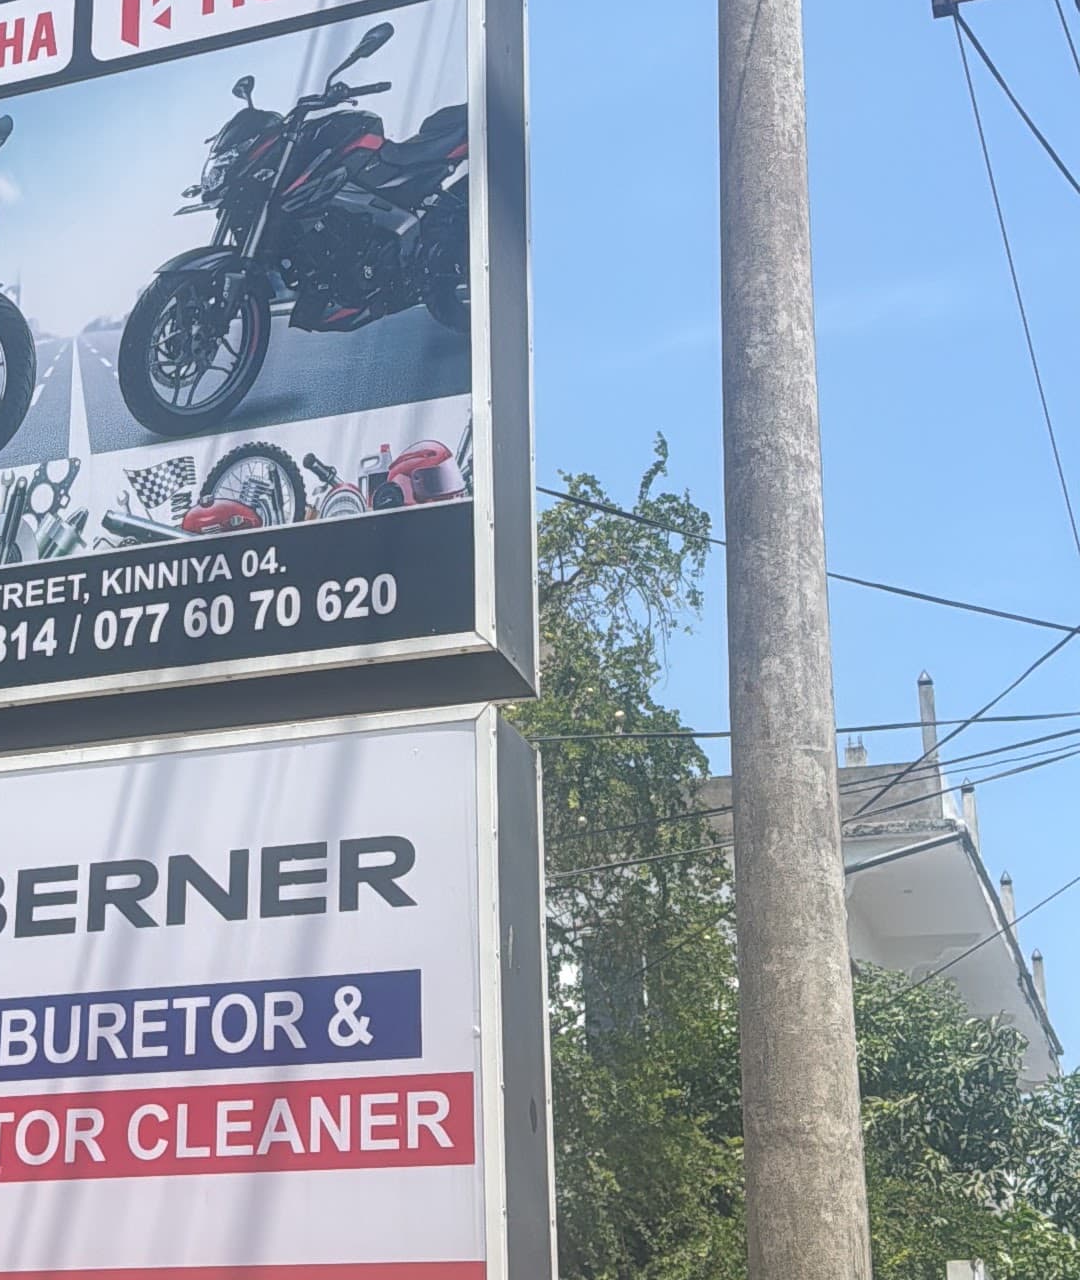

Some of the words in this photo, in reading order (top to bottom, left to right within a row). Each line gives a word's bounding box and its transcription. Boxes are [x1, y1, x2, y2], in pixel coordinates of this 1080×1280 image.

[101, 553, 233, 598] KINNIYA
[240, 546, 287, 578] 04.
[68, 613, 82, 655] /
[93, 602, 170, 651] 077
[182, 595, 235, 639] 60
[248, 586, 302, 631] 70
[315, 573, 398, 622] 620
[327, 985, 374, 1048] &
[127, 1089, 455, 1161] CLEANER
